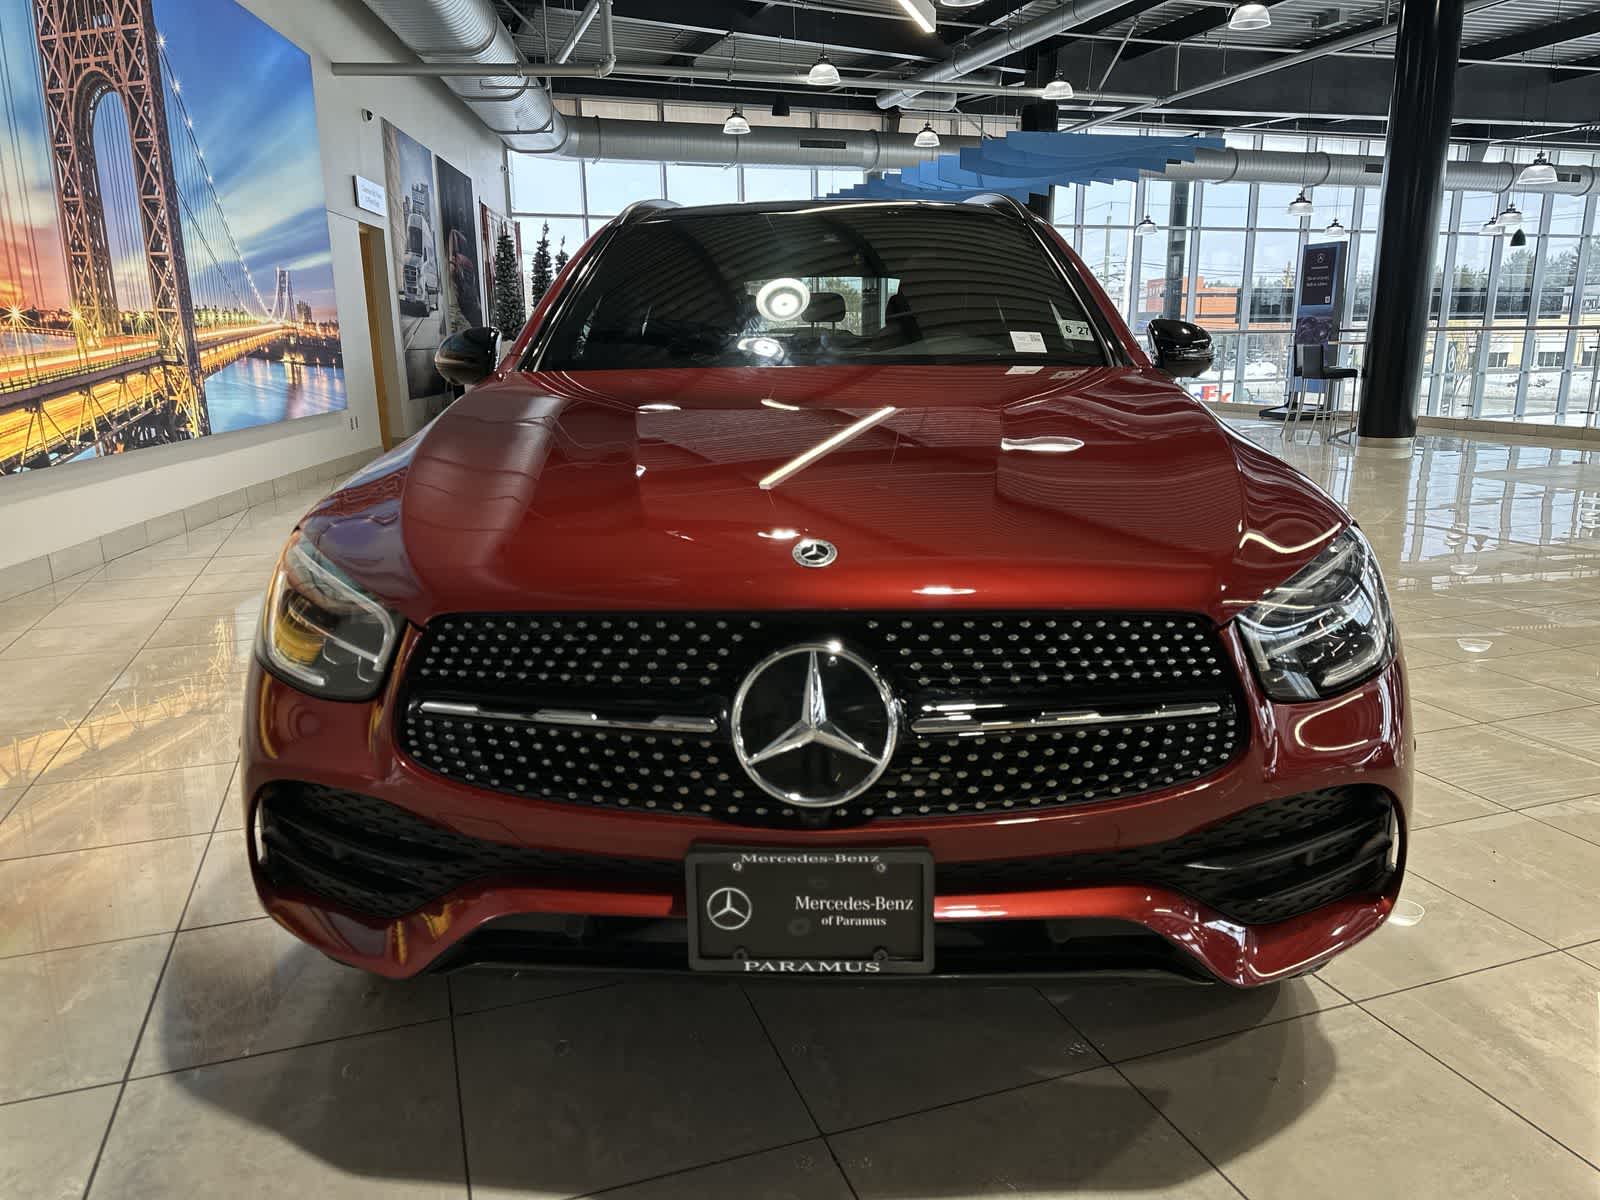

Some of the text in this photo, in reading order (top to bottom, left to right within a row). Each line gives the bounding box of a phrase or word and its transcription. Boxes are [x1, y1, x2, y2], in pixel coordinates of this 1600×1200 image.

[1065, 325, 1088, 335] 6 27
[740, 853, 881, 864] Mercedes-Benz
[795, 896, 914, 911] Mercedes-Benz
[821, 915, 887, 927] of Paramus
[743, 960, 881, 973] PARAMUS
